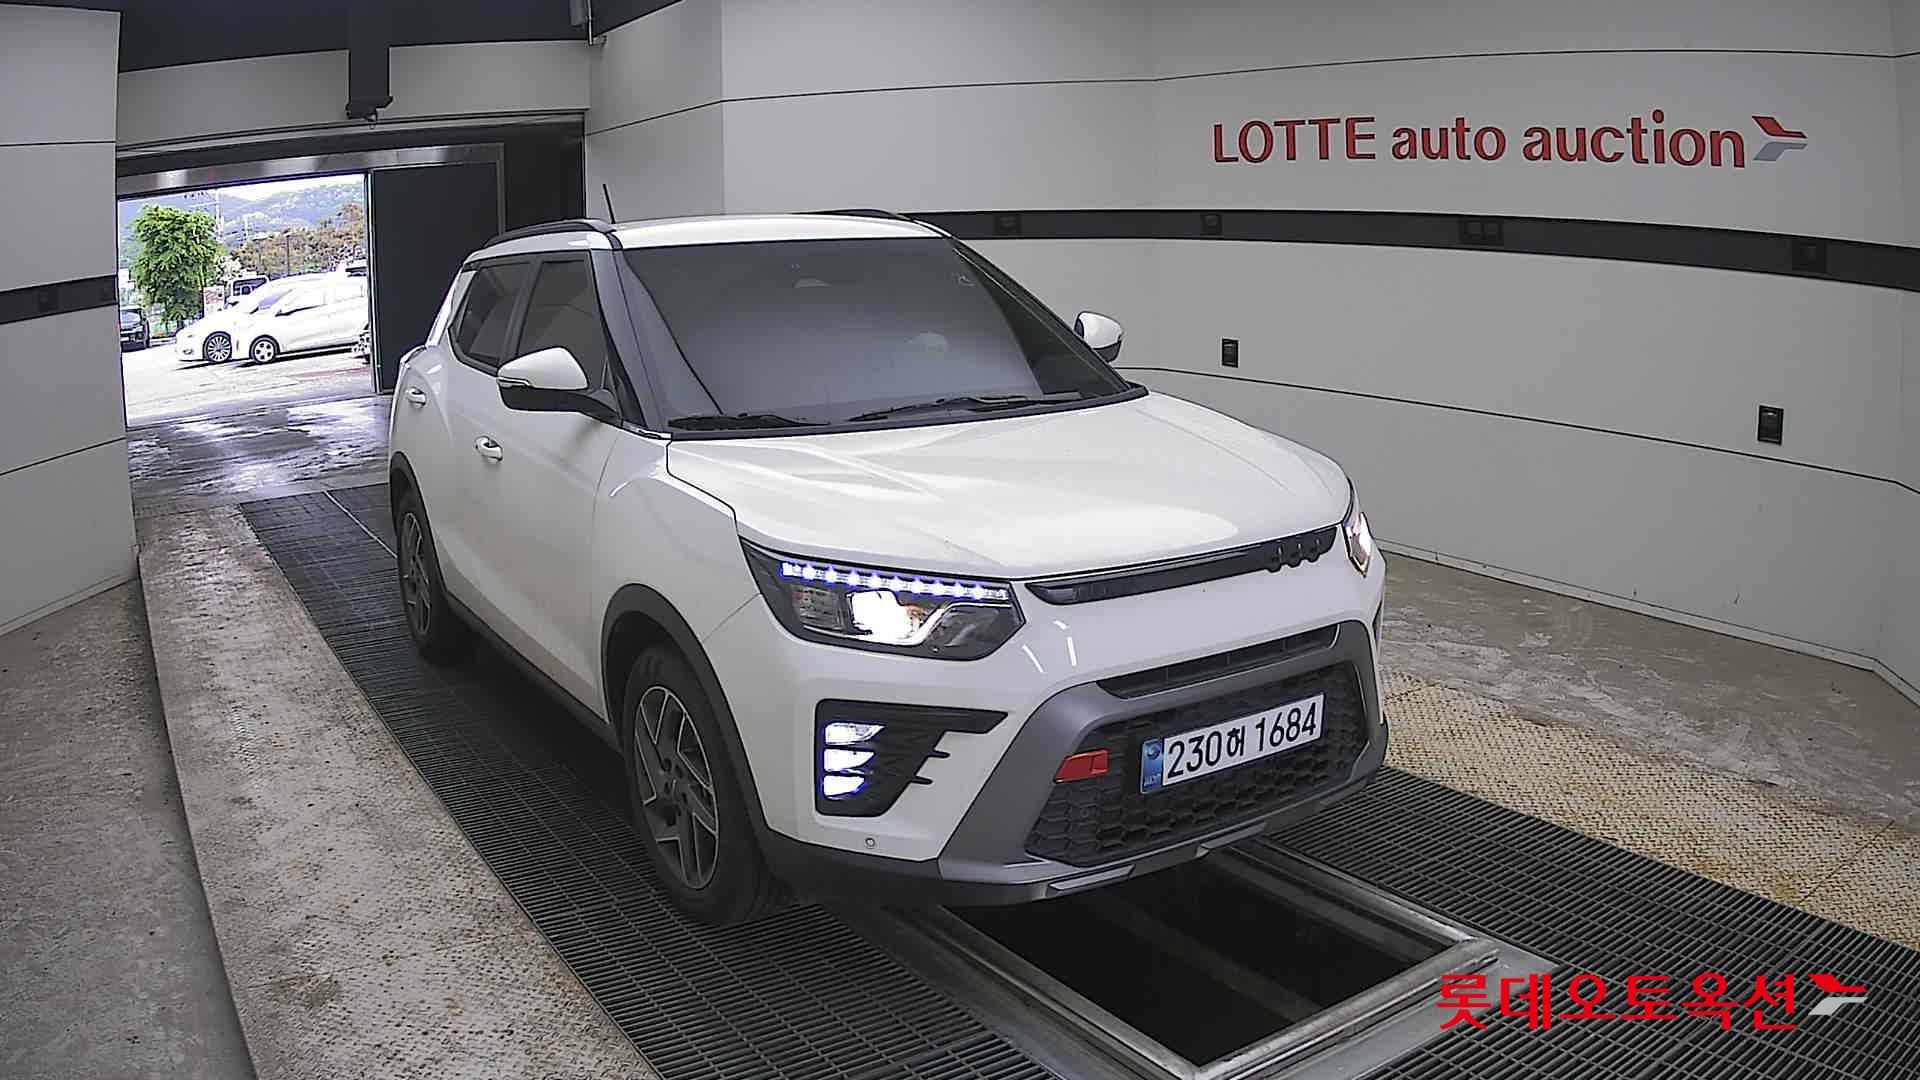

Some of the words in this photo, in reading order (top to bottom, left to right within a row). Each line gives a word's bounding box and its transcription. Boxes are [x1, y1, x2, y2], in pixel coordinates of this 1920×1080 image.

[1213, 117, 1376, 164] LOTTE
[1391, 116, 1506, 161] auto
[1523, 109, 1745, 168] auction
[1166, 725, 1246, 779] 230허
[1255, 702, 1317, 752] 1684
